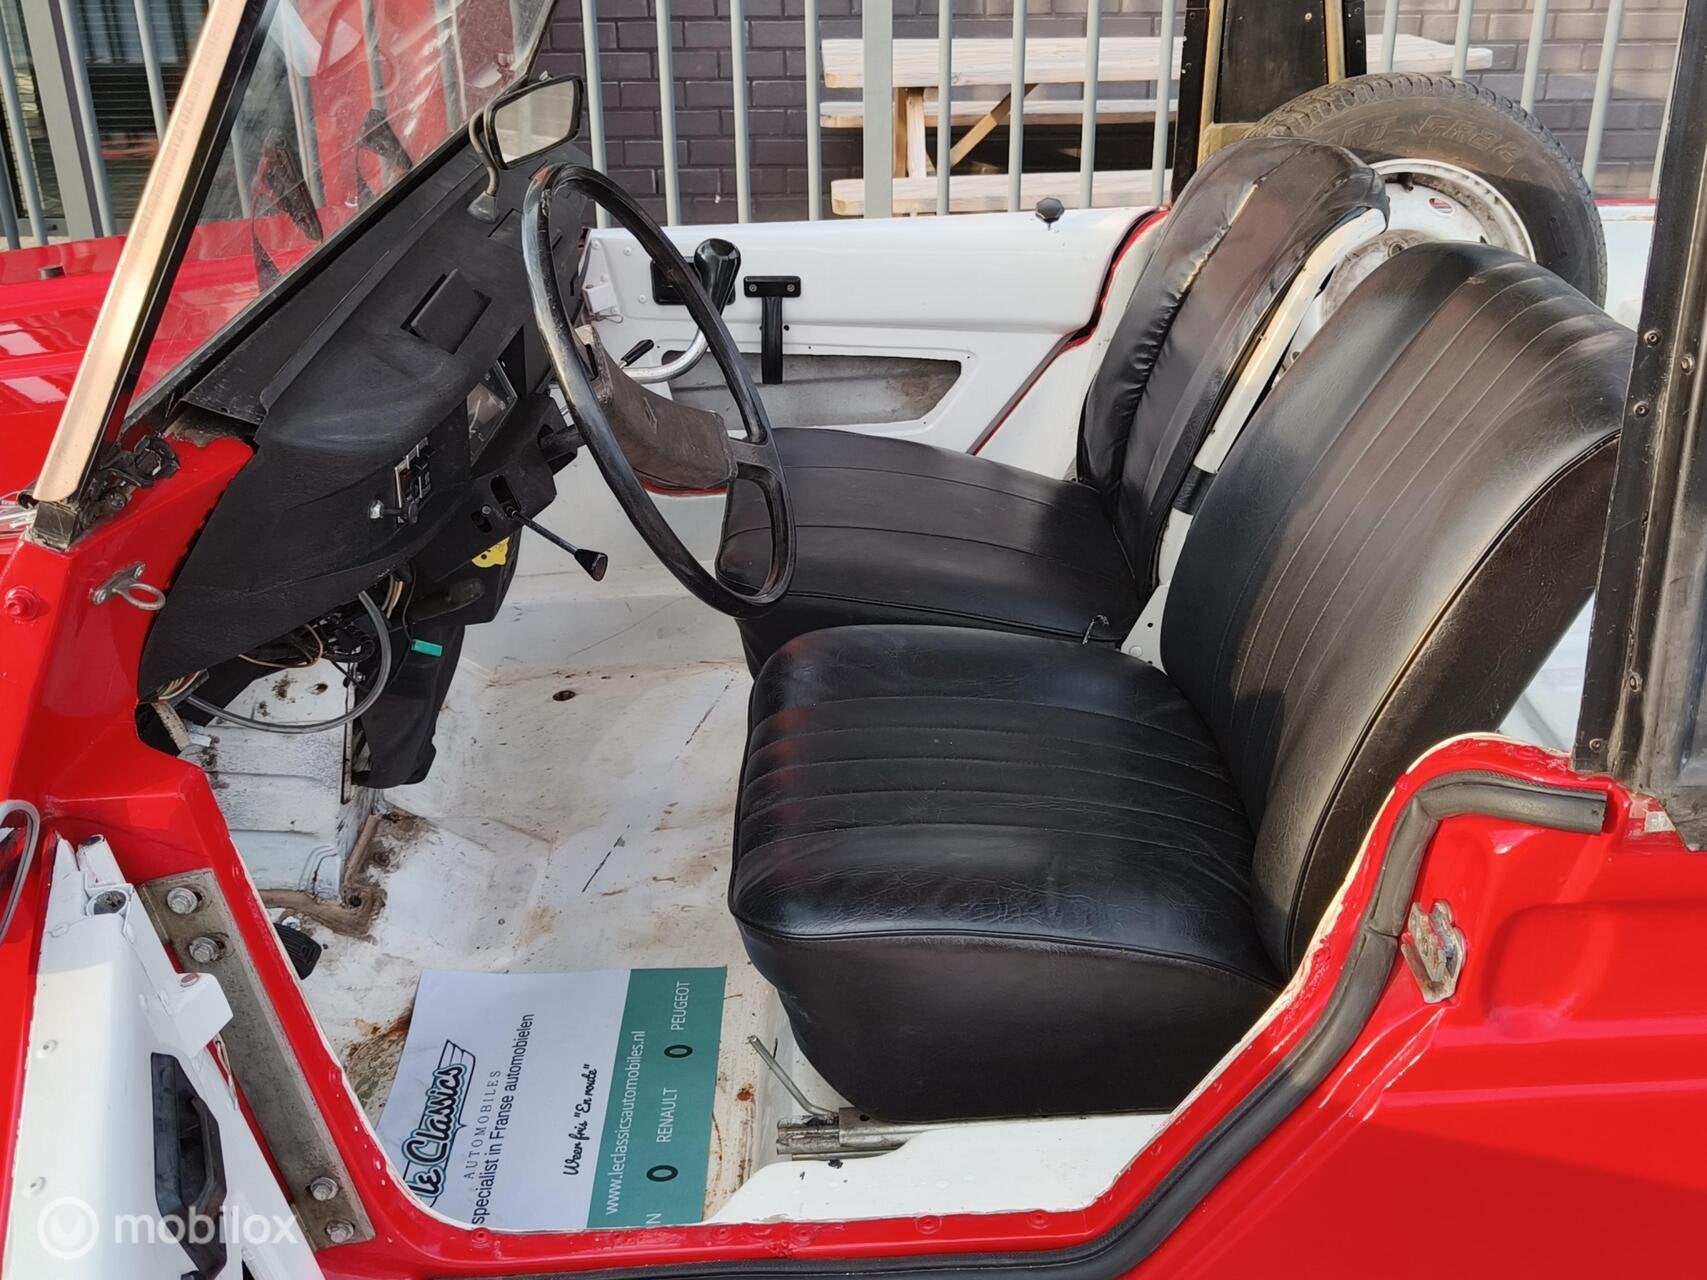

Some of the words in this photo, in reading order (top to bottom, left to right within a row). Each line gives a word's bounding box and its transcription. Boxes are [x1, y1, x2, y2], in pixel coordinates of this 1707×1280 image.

[504, 1013, 535, 1092] automobielen
[580, 1063, 598, 1096] route"
[656, 1087, 678, 1144] RENAULT
[670, 981, 691, 1032] PEUGEOT
[404, 1065, 464, 1164] Classics
[463, 1070, 501, 1179] AUTOMOBILES
[489, 1094, 515, 1140] Franse
[568, 1120, 590, 1141] fris
[605, 1030, 646, 1216] www.leclassicsautomobiles.nl
[489, 1143, 503, 1157] in
[563, 1140, 583, 1176] Weer
[471, 1157, 500, 1225] specialist
